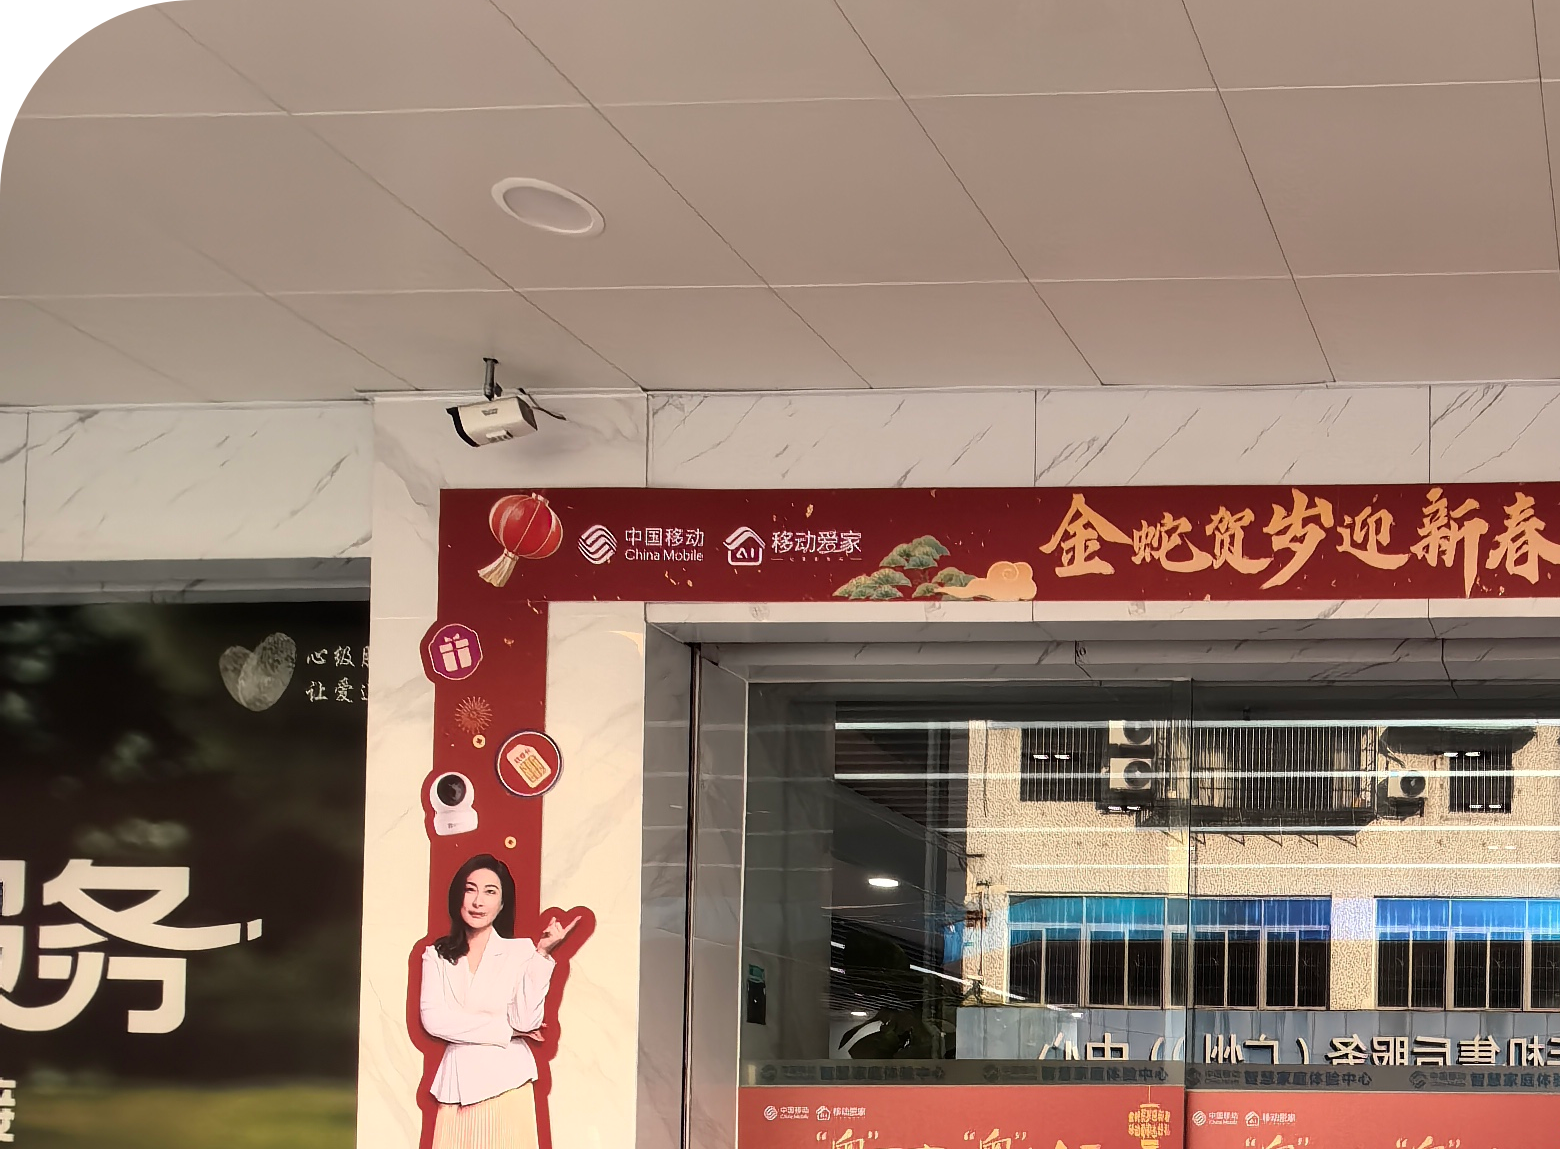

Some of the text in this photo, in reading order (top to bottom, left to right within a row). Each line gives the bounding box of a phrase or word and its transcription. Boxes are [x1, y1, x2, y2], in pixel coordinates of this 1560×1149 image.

[625, 527, 704, 547] 中国移动
[771, 530, 862, 553] 移动爱家
[625, 549, 704, 561] China Mobile
[0, 858, 262, 1034] 务
